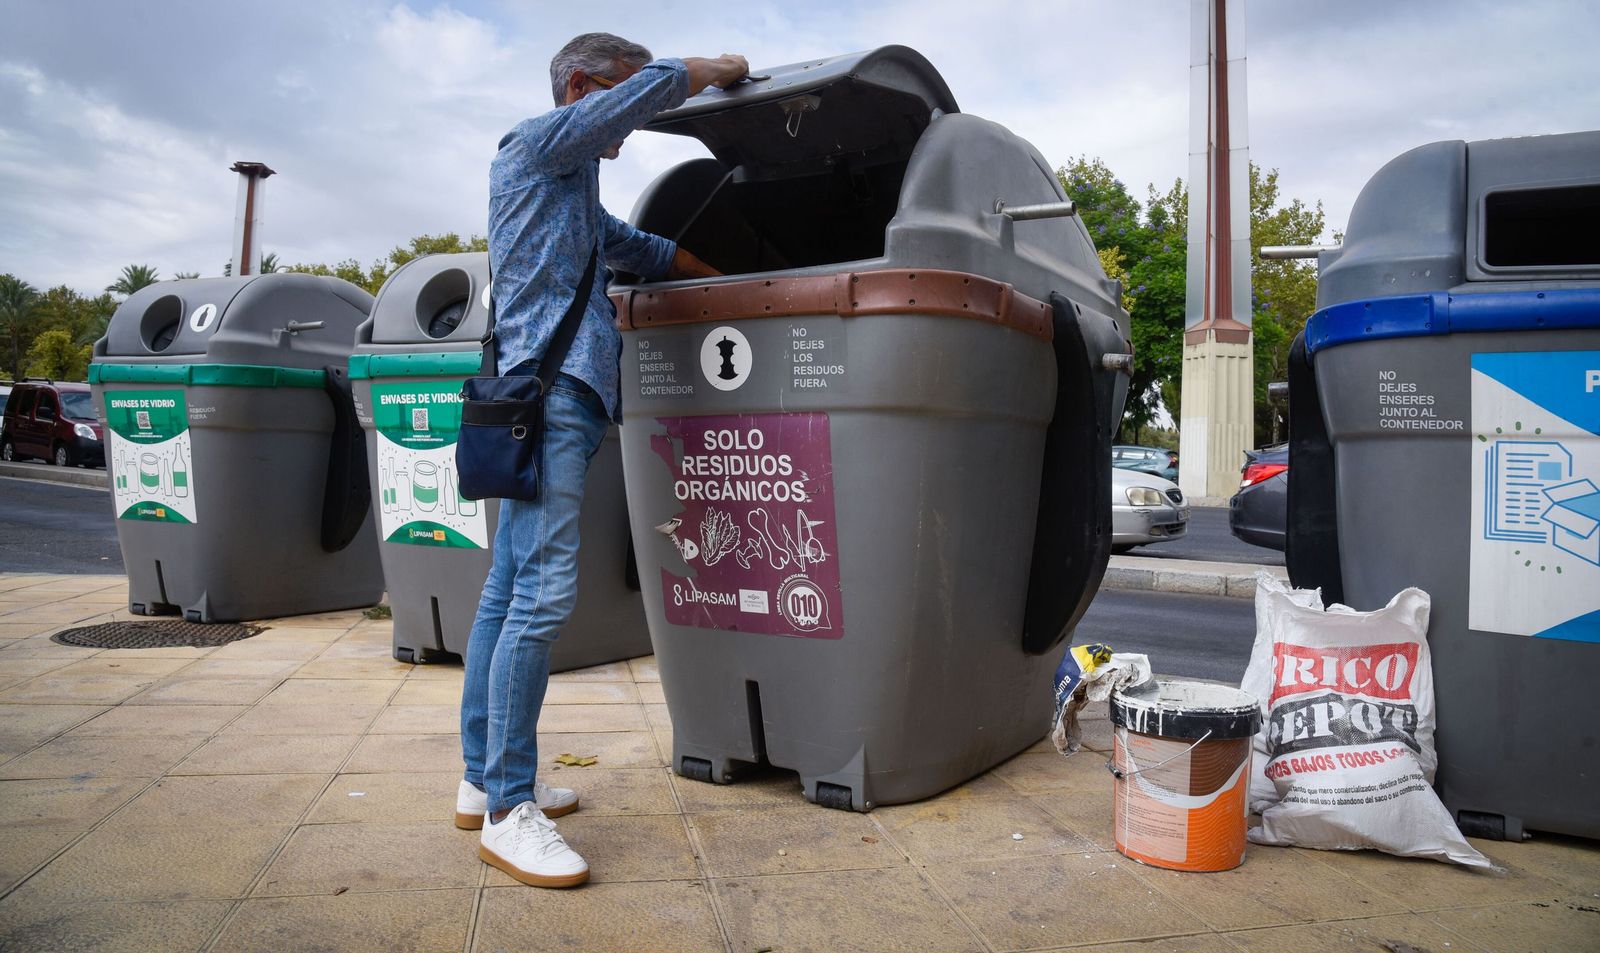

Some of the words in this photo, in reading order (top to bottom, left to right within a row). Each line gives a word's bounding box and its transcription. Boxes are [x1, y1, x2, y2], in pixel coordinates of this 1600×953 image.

[792, 328, 807, 337] NO
[638, 341, 649, 349] NO
[792, 340, 825, 350] DEJES
[639, 351, 663, 360] DEJES
[793, 353, 813, 363] LOS
[640, 362, 675, 372] ENSERES
[793, 365, 845, 376] RESIDUOS
[640, 374, 665, 384] JUNTO
[666, 374, 676, 383] AL
[1379, 370, 1396, 381] NO
[794, 378, 827, 388] FUERA
[1379, 383, 1417, 393] DEJES
[641, 385, 694, 395] CONTENEDOR
[112, 399, 139, 408] ENVASES
[140, 399, 149, 408] DE
[150, 399, 175, 408] VIDRIO
[381, 393, 416, 405] ENVASES
[418, 393, 430, 404] DE
[1379, 395, 1435, 405] ENSERES
[1379, 407, 1418, 417] JUNTO
[1420, 407, 1437, 417] AL
[1379, 419, 1464, 430] CONTENEDOR
[703, 428, 764, 451] SOLO
[682, 454, 793, 476] RESIDUOS
[674, 475, 806, 502] ORGÁNICOS
[685, 590, 737, 606] LIPASAM
[790, 593, 819, 618] 010
[1290, 754, 1336, 774] BAJOS
[1336, 750, 1385, 769] TODOS
[1307, 788, 1318, 796] que
[1337, 796, 1364, 805] abandono
[1365, 796, 1374, 804] del
[1375, 795, 1388, 803] saco
